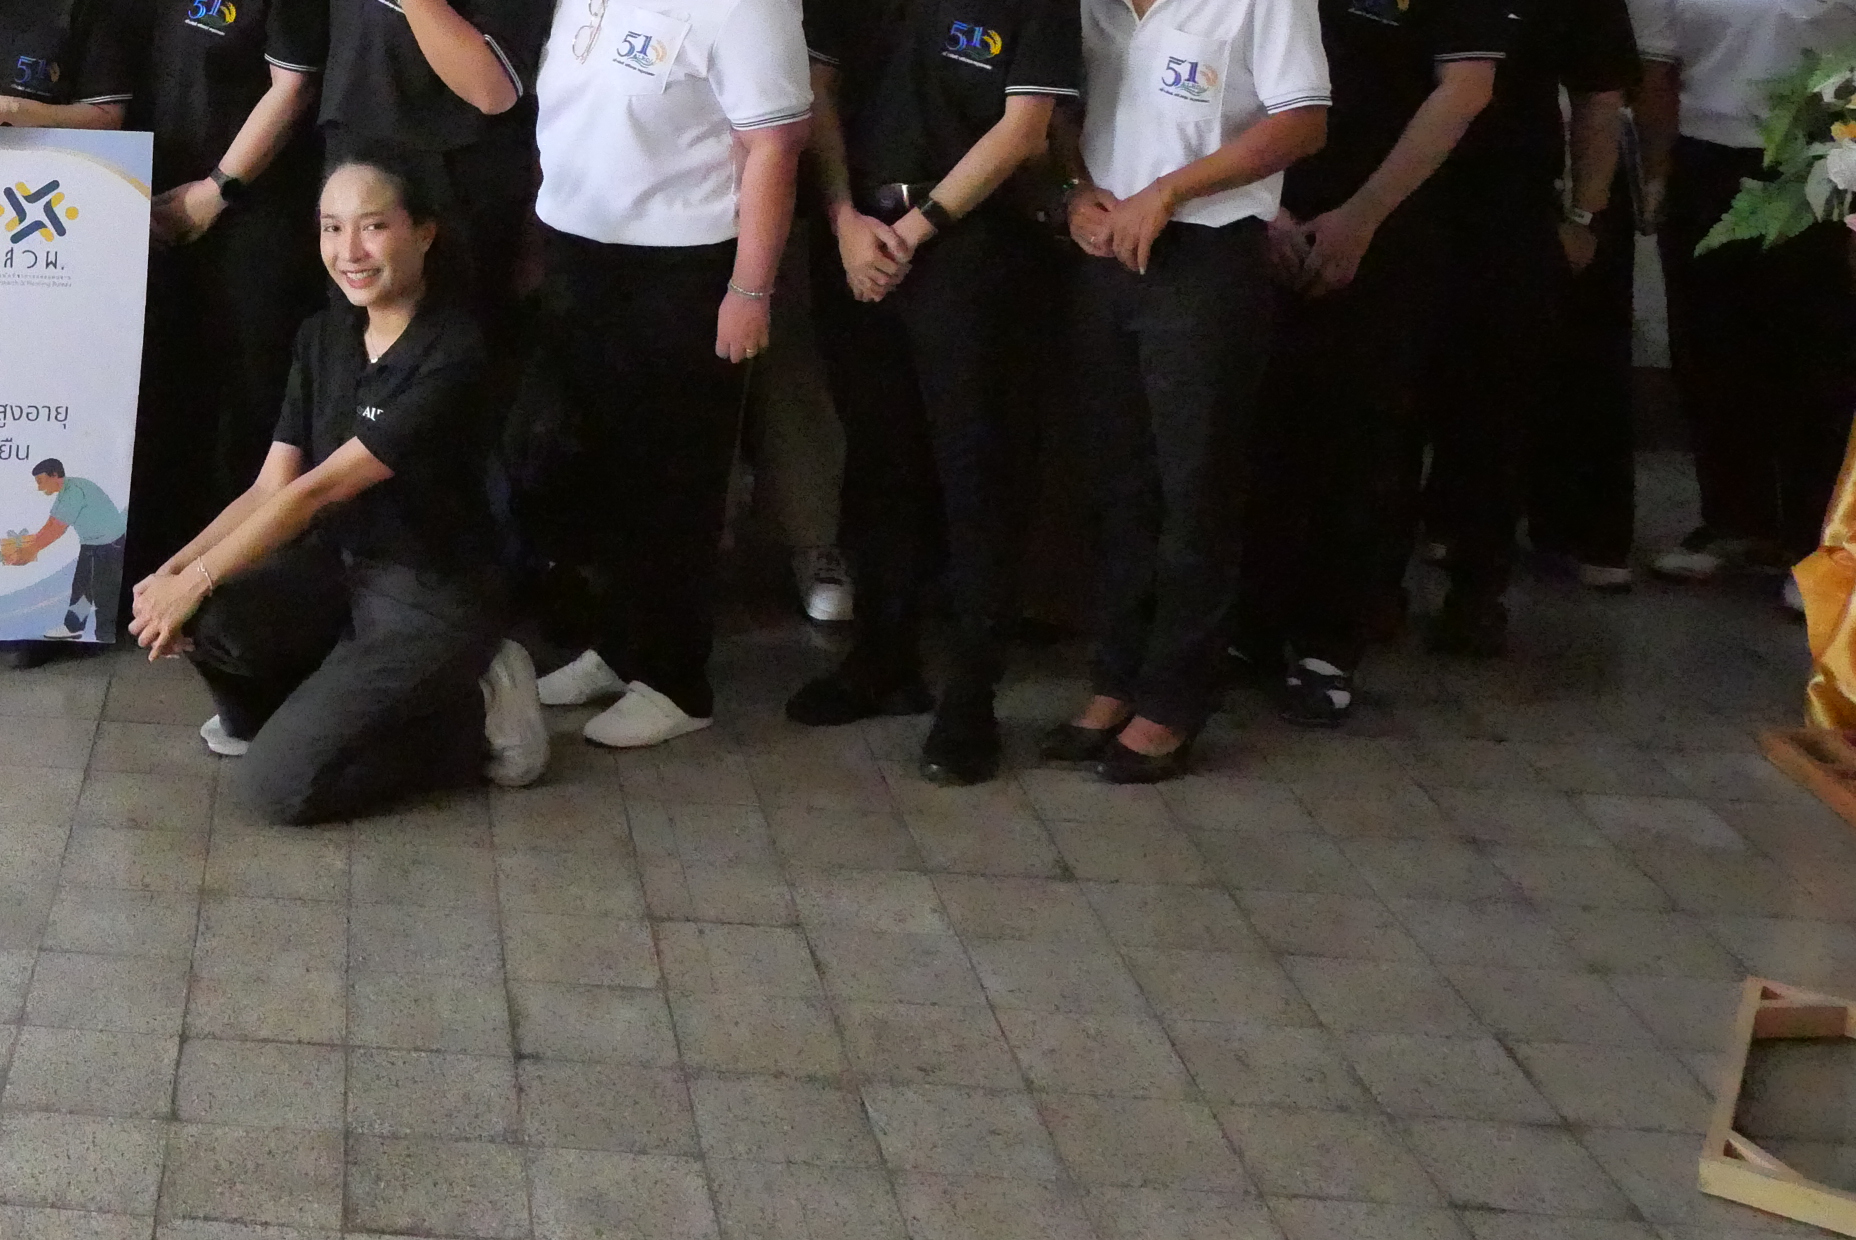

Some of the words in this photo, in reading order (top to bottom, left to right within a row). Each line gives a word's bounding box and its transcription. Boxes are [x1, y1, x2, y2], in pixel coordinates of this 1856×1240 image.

[616, 31, 652, 57] 51
[945, 21, 983, 51] 51
[1161, 56, 1198, 87] 51
